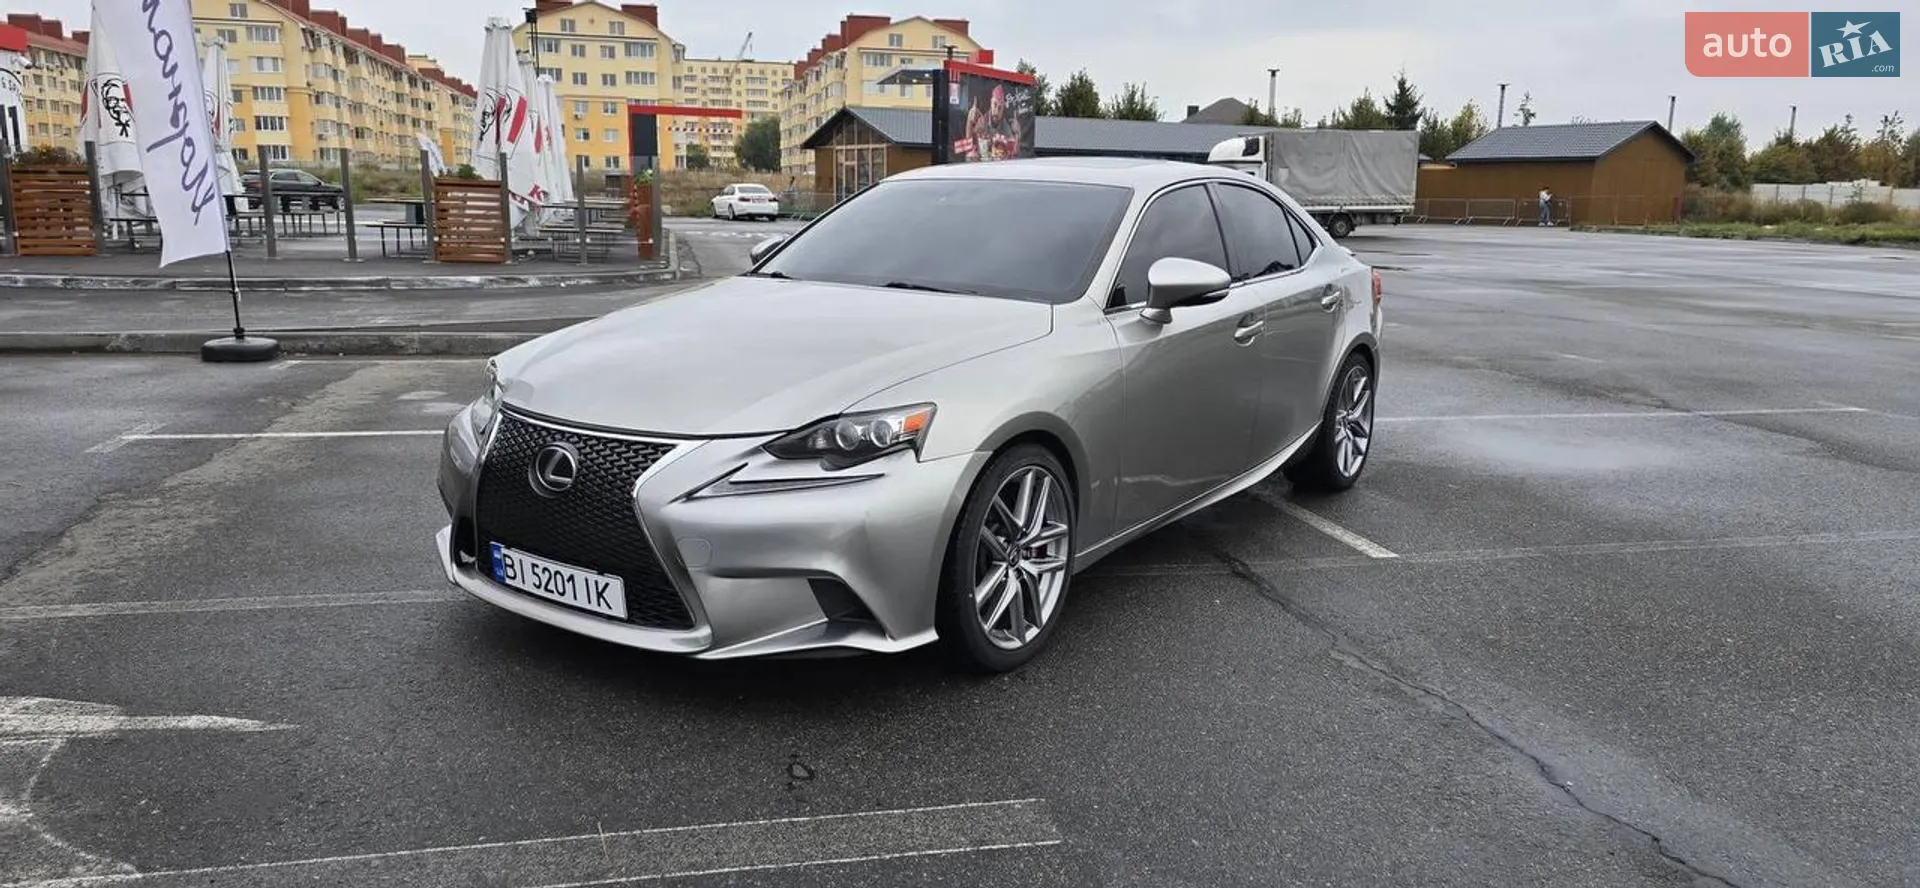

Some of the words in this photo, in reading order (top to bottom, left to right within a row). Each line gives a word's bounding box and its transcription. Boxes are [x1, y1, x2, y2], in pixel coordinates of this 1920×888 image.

[503, 553, 525, 584] BI
[531, 562, 577, 601] 5201
[585, 577, 612, 610] IK
